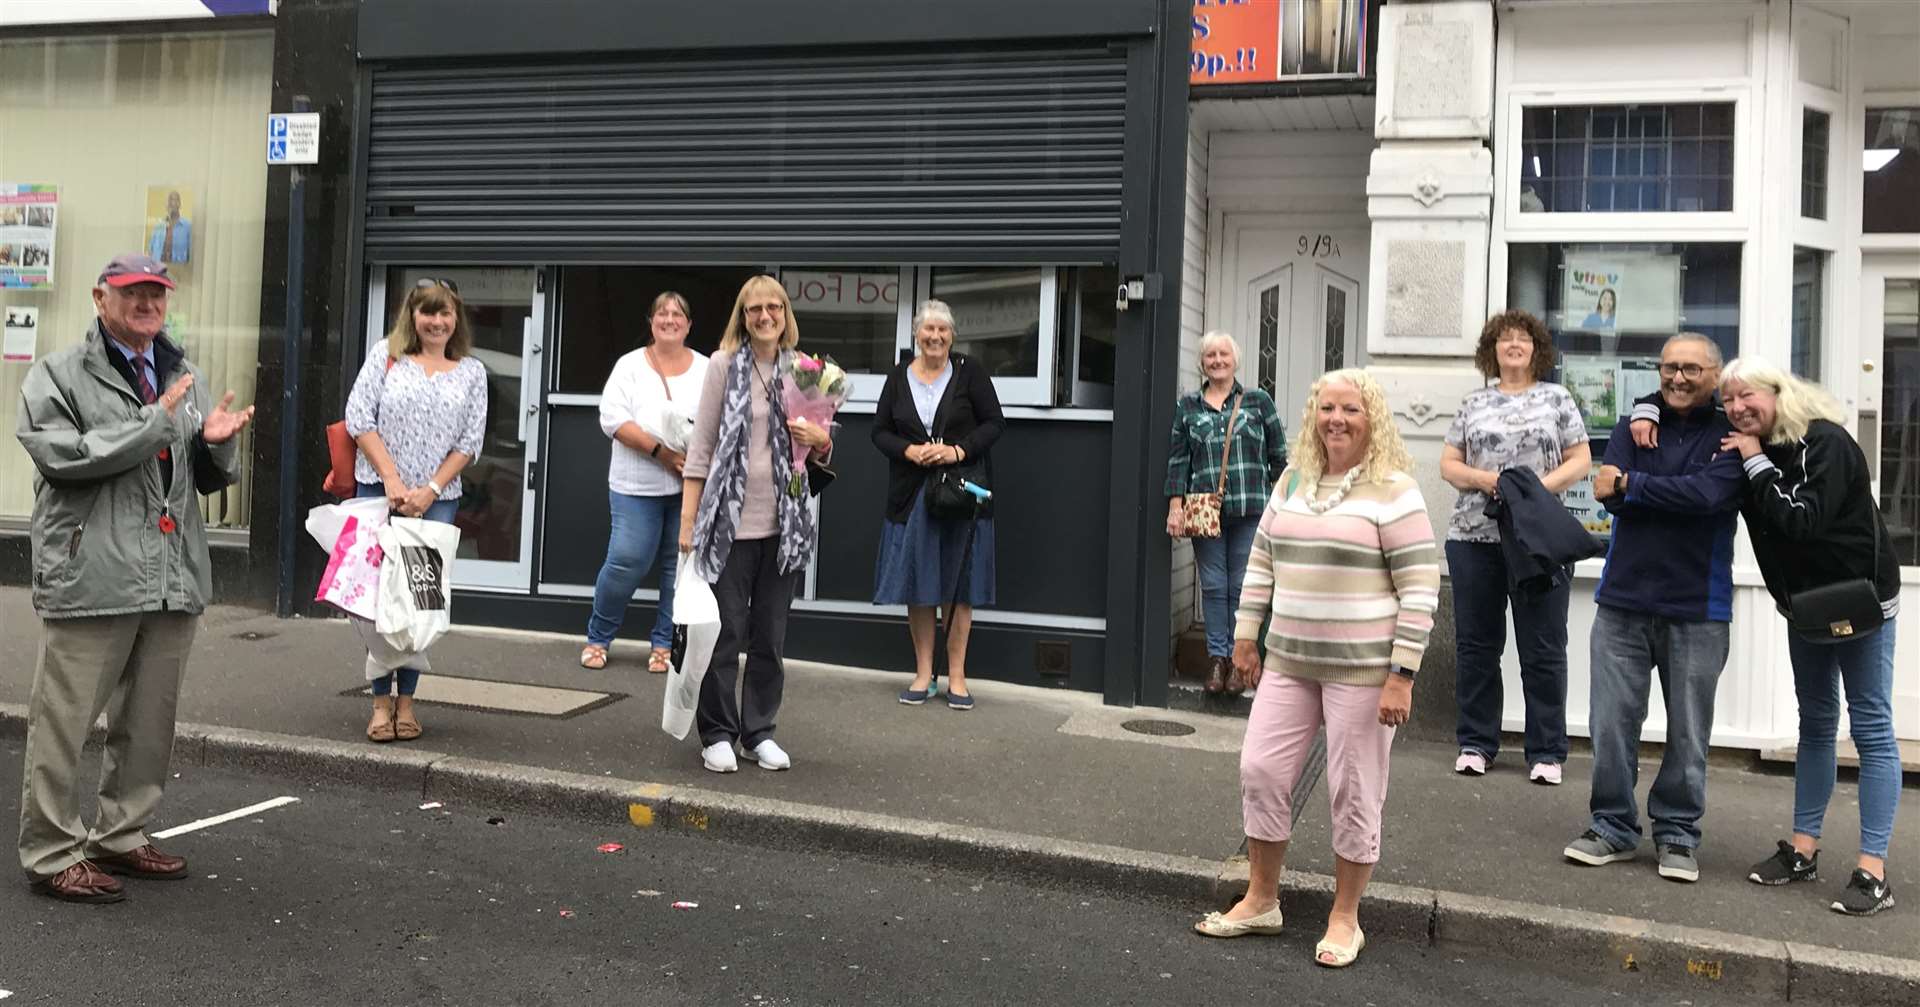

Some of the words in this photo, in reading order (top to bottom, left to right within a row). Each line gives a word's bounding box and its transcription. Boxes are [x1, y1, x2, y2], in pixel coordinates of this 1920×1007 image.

[289, 120, 317, 128] Disabled
[411, 563, 436, 582] &S
[410, 583, 429, 592] OOD
